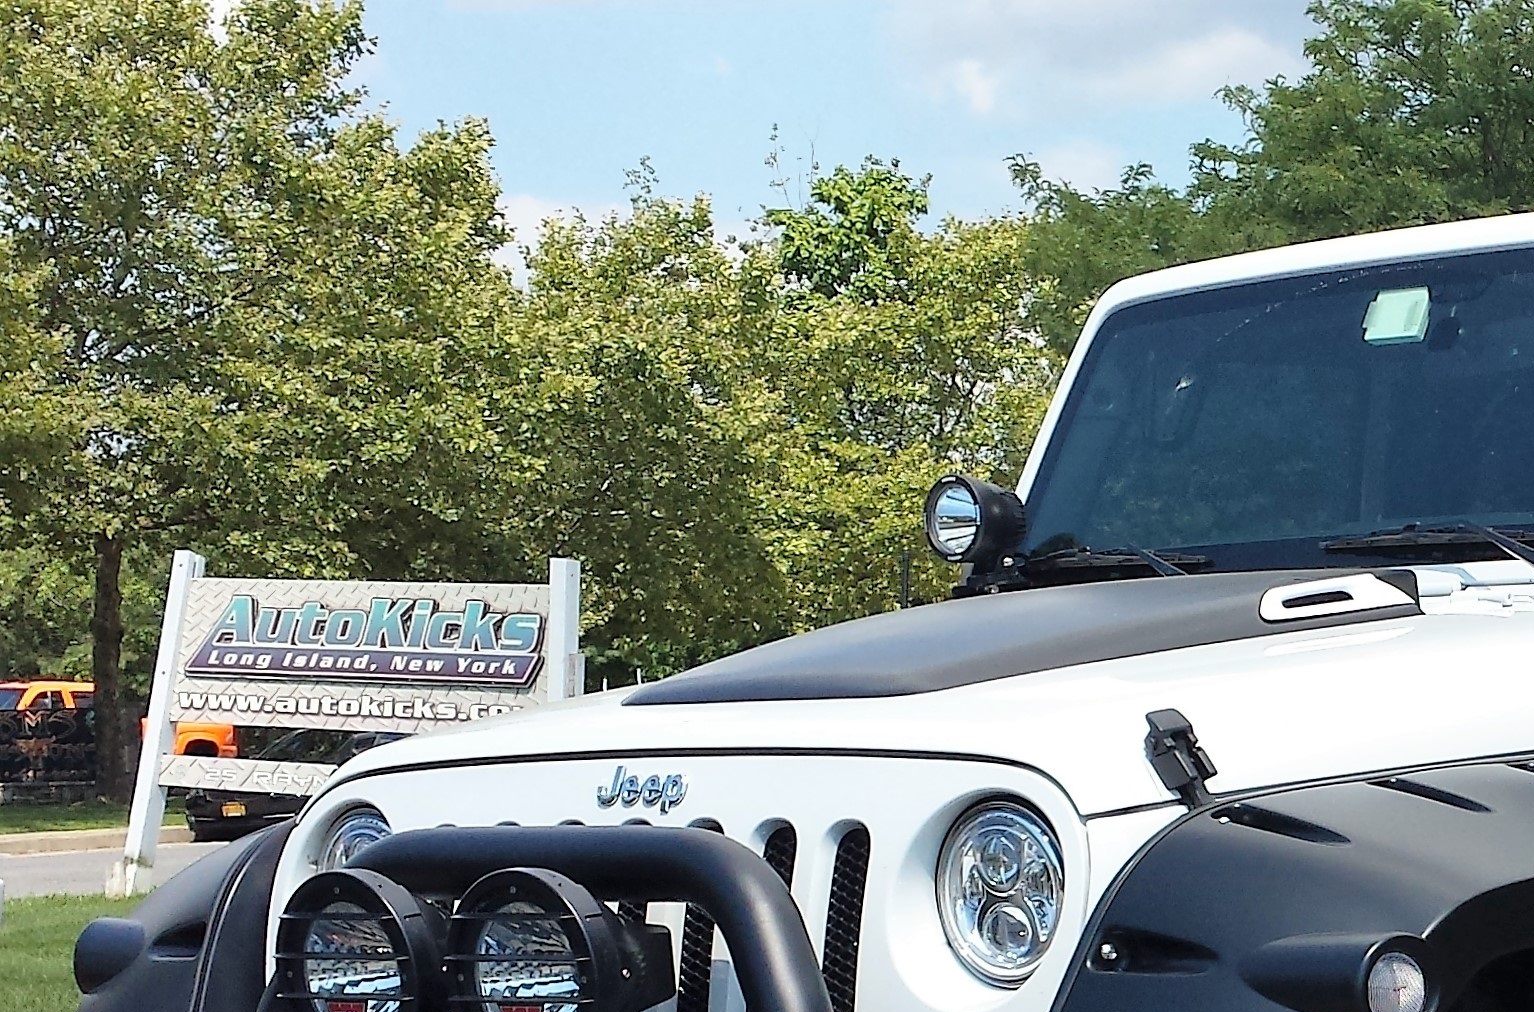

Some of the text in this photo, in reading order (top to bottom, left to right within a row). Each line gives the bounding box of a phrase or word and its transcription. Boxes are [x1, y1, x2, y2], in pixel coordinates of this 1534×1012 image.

[212, 595, 545, 652] AutoKicks
[207, 648, 518, 676] Long Island, New York
[178, 691, 524, 721] www.autokicks.co
[205, 767, 237, 781] 25
[597, 765, 688, 815] Jeep
